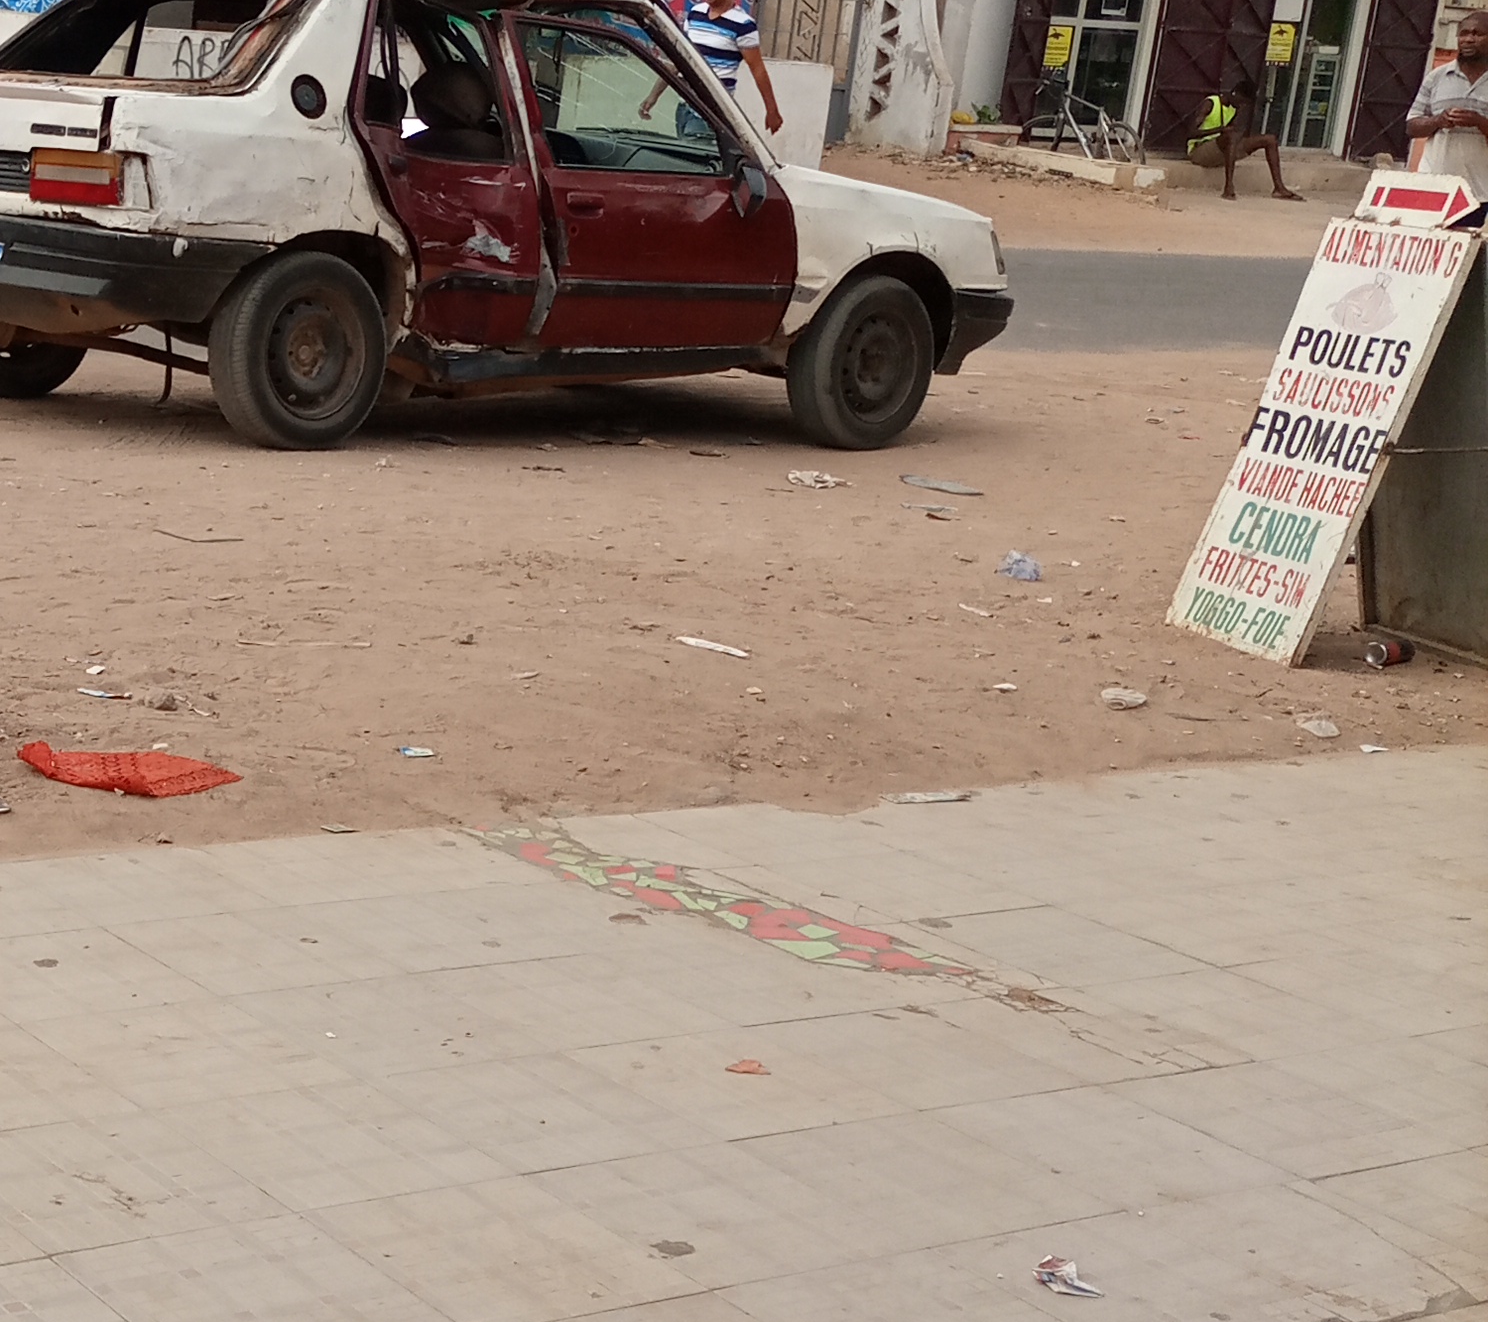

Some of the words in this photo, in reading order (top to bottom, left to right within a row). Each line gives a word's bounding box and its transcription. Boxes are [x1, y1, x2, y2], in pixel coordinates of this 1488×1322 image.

[1319, 226, 1447, 276] ALIMENTATION
[1288, 325, 1412, 379] POULETS
[1272, 367, 1396, 421] SAUCISSONS
[1244, 405, 1388, 475] FROMAGE
[1237, 457, 1304, 505] VIANDE
[1296, 471, 1369, 518] HACHEE
[1228, 501, 1323, 565] CENDRA
